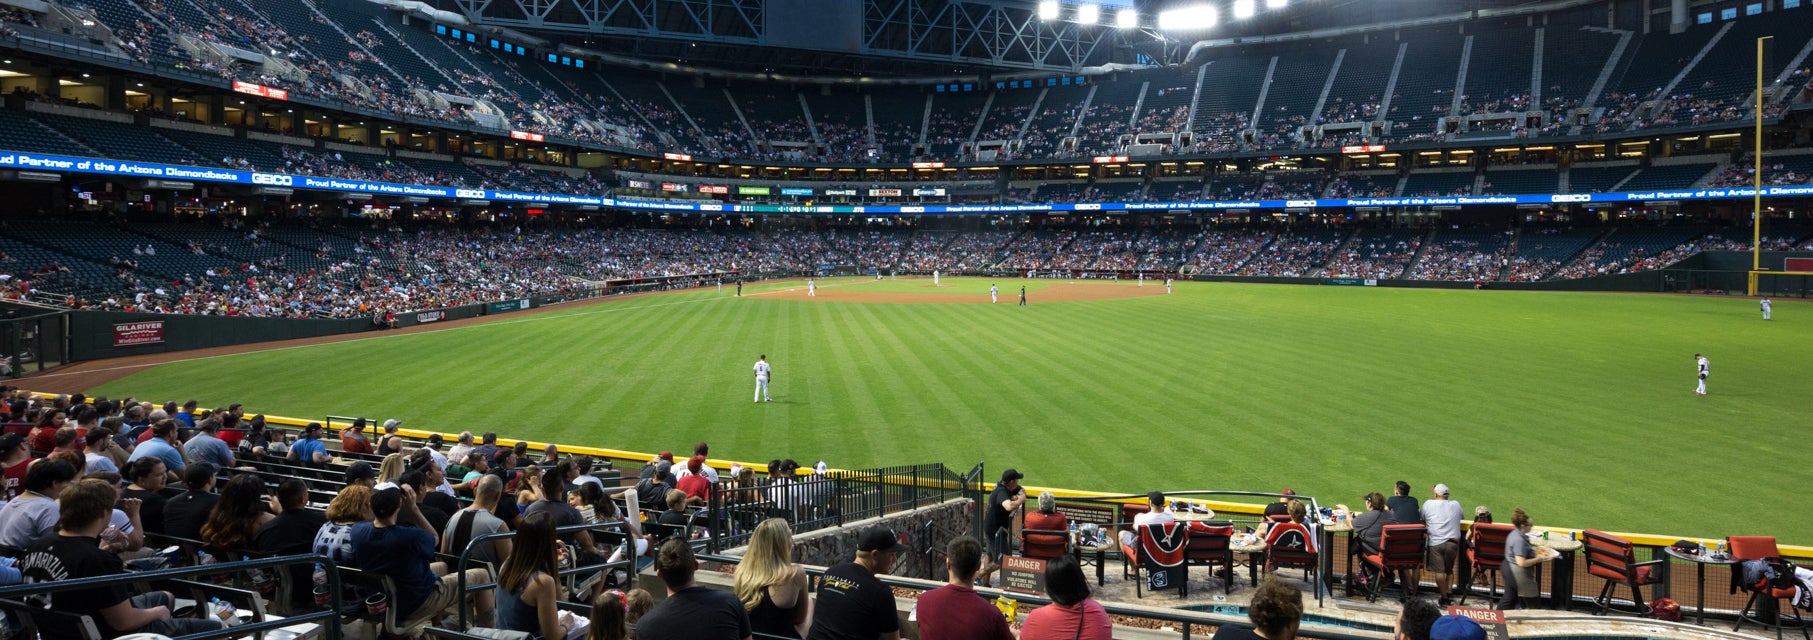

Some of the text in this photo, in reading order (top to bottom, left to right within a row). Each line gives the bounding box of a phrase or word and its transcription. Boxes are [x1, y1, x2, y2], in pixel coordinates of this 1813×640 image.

[19, 156, 73, 169] Partner
[77, 161, 91, 170] of
[94, 162, 115, 172] the
[119, 164, 162, 175] Arizona
[166, 167, 237, 181] Diamondbacks
[252, 173, 292, 186] GEICO
[306, 179, 329, 188] Proud
[331, 181, 358, 189] Partner
[380, 185, 403, 193] Arizona
[404, 186, 446, 195] Diamondbacks
[456, 189, 485, 198] GEICO
[514, 193, 534, 201] Partner
[1552, 194, 1590, 202] GEICO
[1657, 191, 1693, 199] Partner
[1008, 558, 1040, 571] DANGER
[1455, 609, 1498, 621] DANGER
